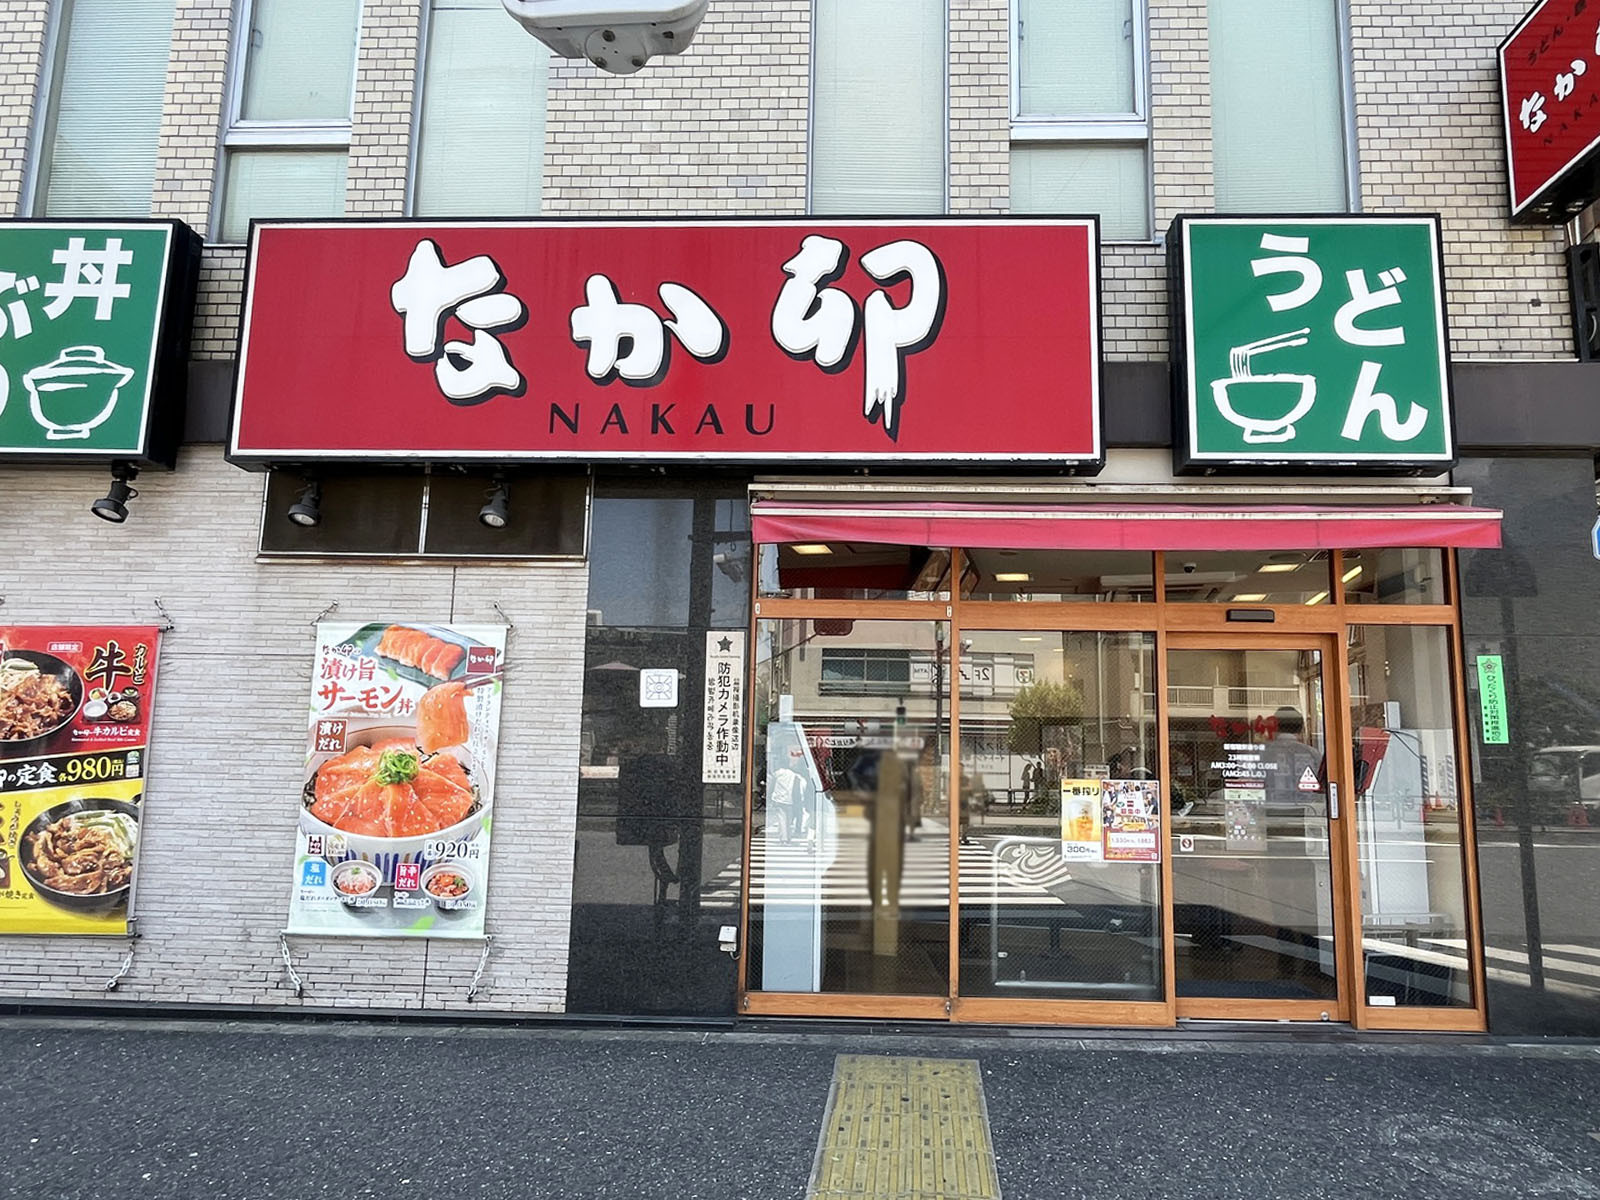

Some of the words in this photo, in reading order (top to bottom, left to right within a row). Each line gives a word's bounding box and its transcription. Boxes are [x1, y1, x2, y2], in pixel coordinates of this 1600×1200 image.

[1519, 20, 1600, 134] なか
[390, 237, 948, 441] なか卯
[1250, 232, 1429, 442] うどん
[549, 402, 776, 436] NAKAU
[84, 640, 134, 695] 牛
[320, 658, 377, 682] 漬け旨
[319, 721, 344, 735] 漬け
[715, 662, 732, 766] 防犯カメラ作動中
[318, 738, 342, 750] だれ
[1063, 786, 1100, 797] 一番搾り
[435, 841, 480, 859] 920円
